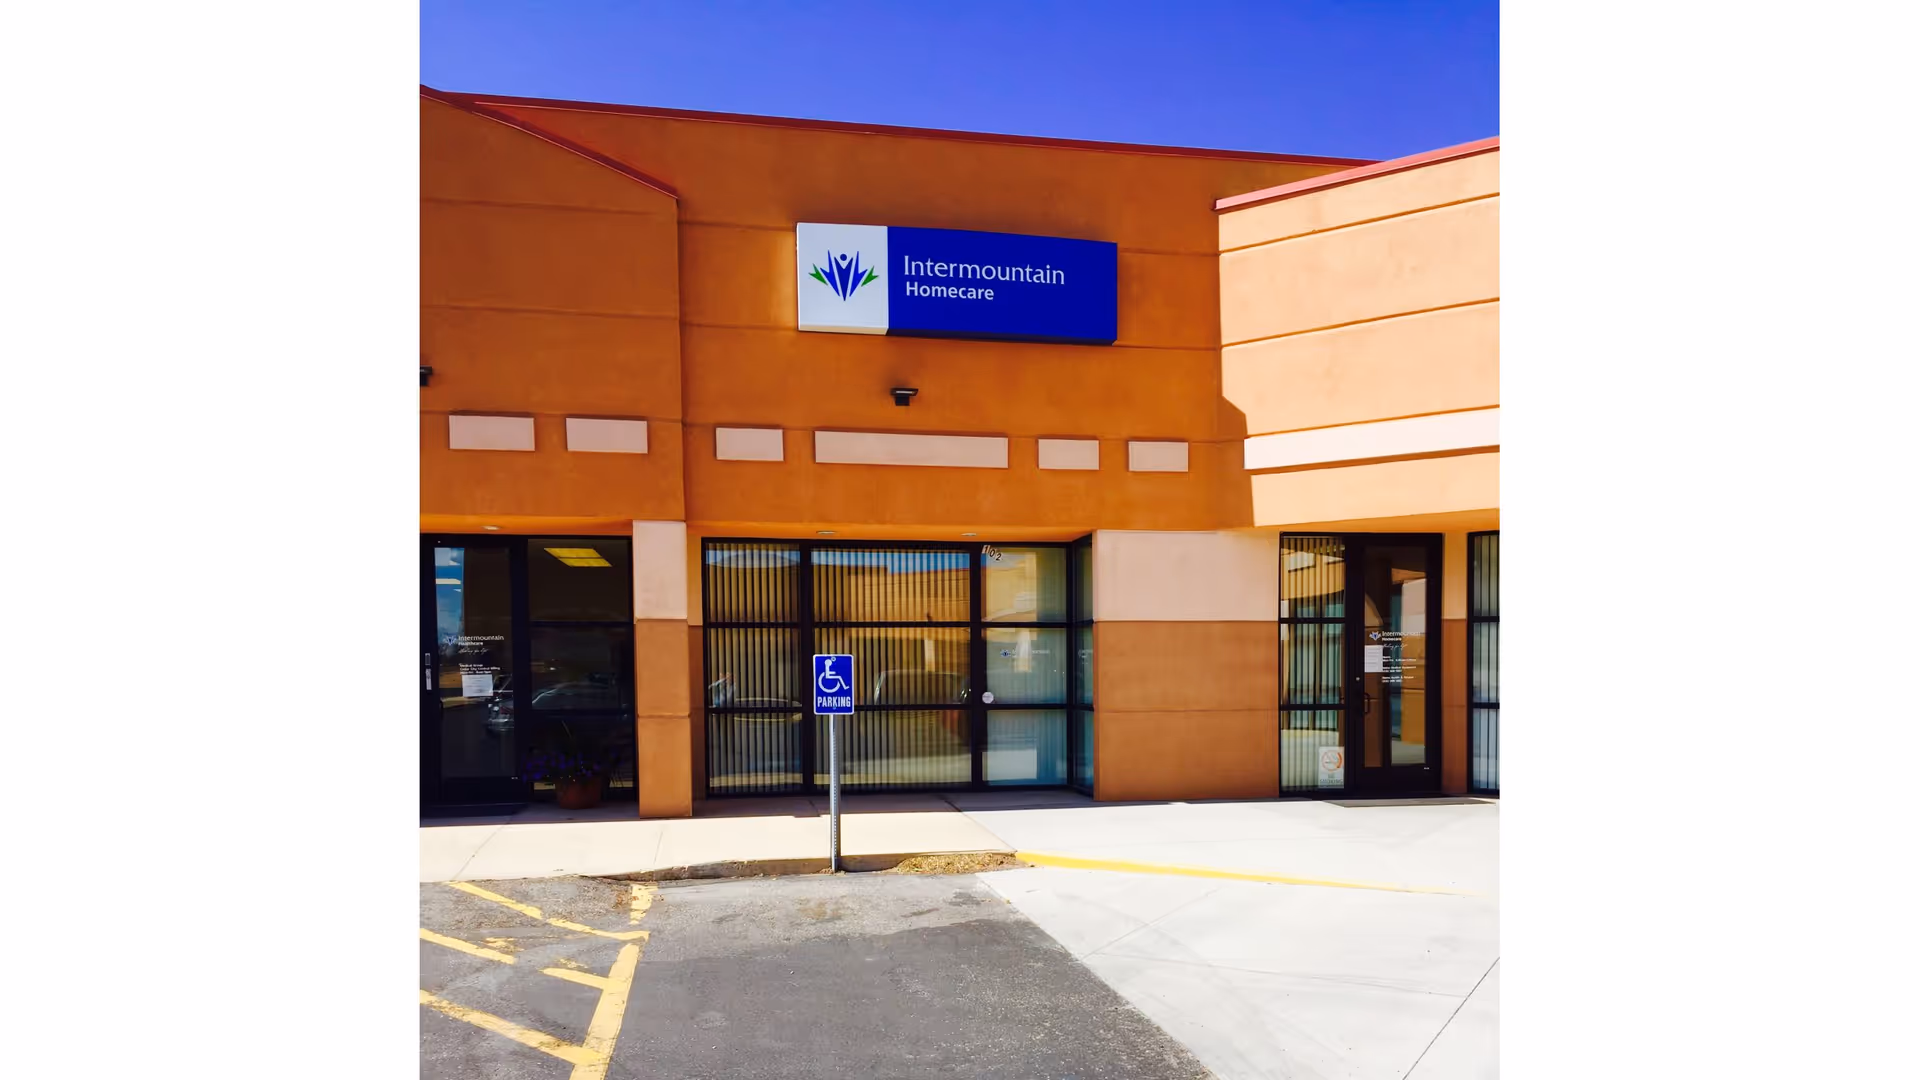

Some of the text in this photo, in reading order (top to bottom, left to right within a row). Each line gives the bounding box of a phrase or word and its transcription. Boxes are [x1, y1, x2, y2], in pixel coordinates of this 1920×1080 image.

[904, 255, 1065, 285] Intermountain
[906, 281, 995, 300] Homecare
[983, 545, 1002, 561] 102
[817, 696, 851, 708] PARKING
